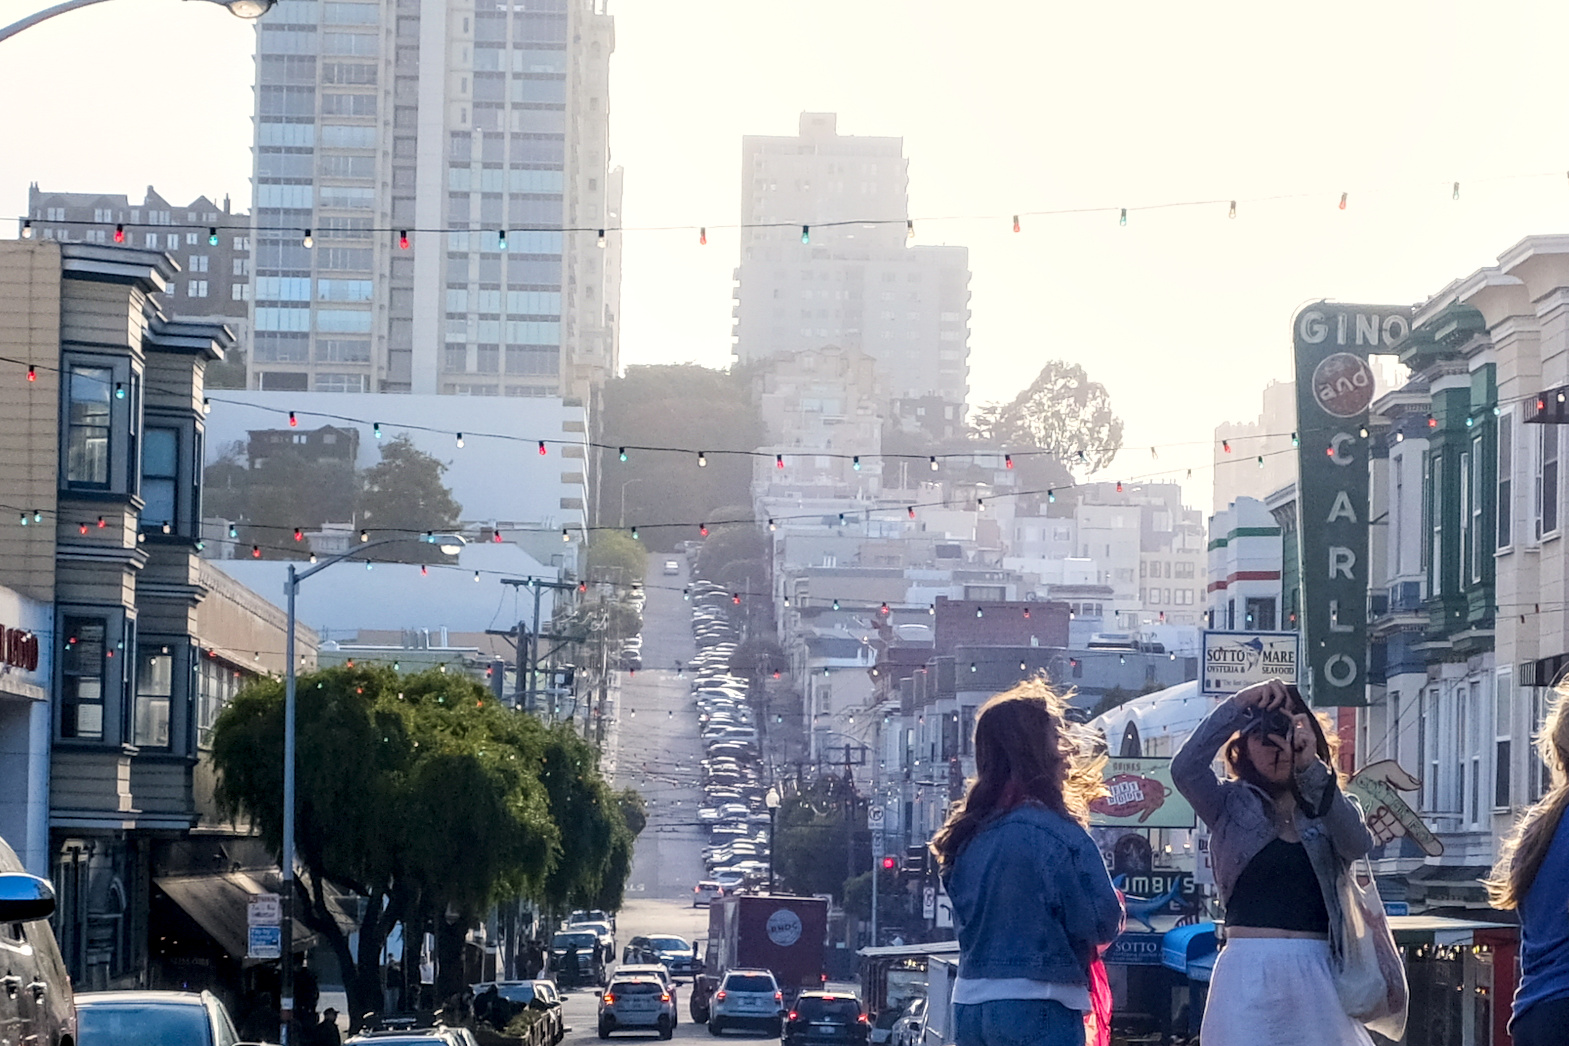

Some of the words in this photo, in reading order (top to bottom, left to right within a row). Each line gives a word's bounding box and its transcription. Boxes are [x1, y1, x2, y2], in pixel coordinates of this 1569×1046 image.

[1300, 311, 1409, 349] GINO
[1320, 364, 1369, 401] and
[1324, 432, 1357, 688] CARLO
[1207, 649, 1245, 662] SOTTO
[1262, 651, 1295, 663] MARE
[1115, 941, 1157, 952] SOTTO
